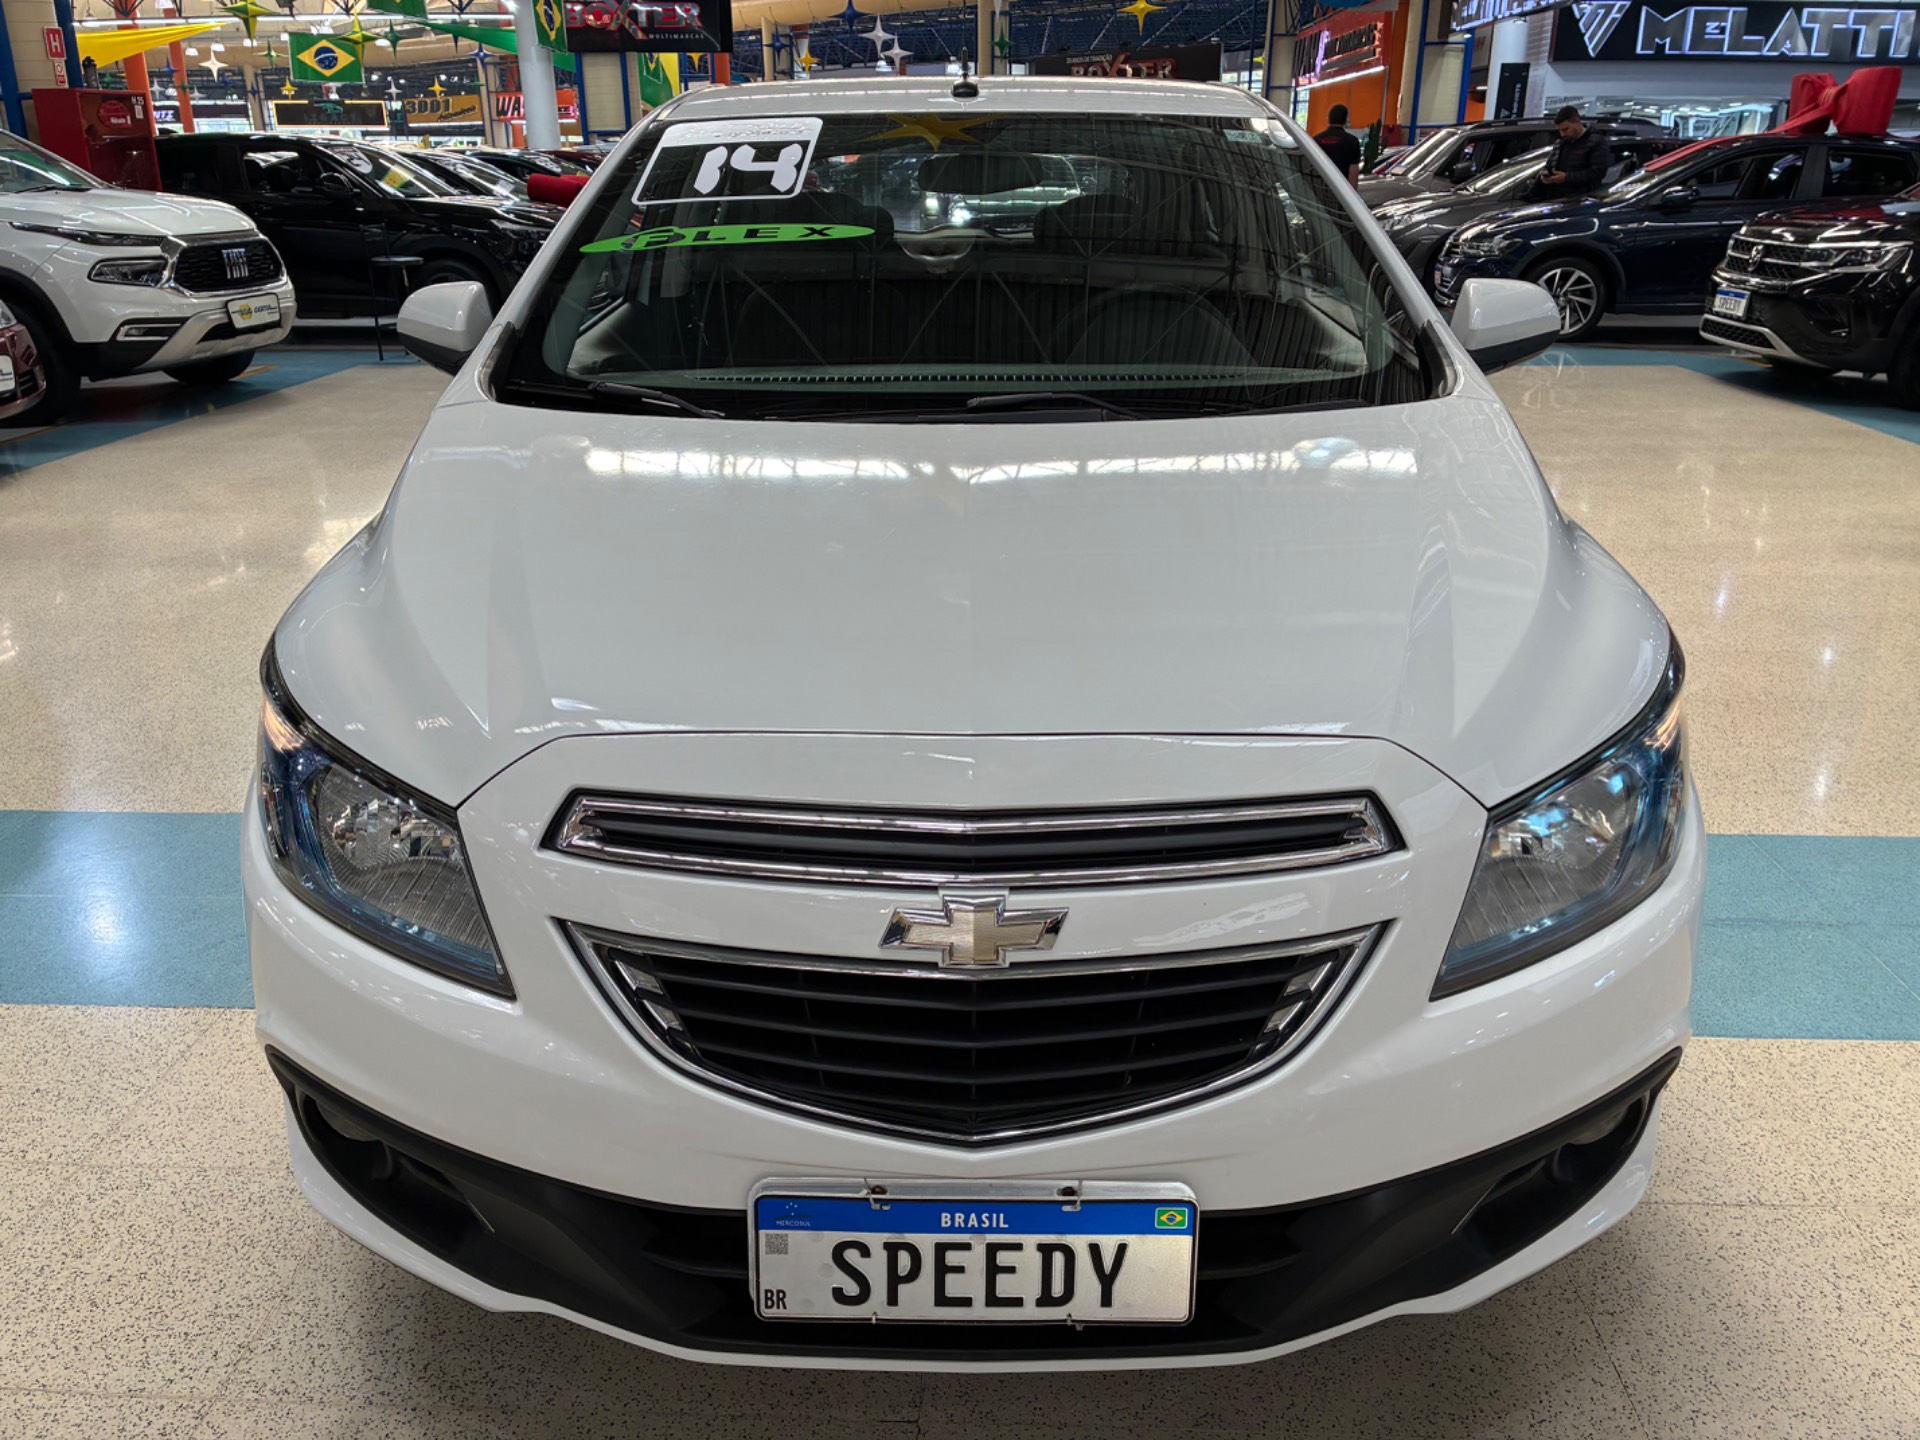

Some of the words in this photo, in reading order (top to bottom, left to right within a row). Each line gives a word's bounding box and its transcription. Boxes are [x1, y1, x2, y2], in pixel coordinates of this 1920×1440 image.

[565, 0, 703, 40] BOXTER
[1635, 6, 1917, 57] MELATTI
[50, 33, 61, 53] H
[693, 144, 803, 194] 14
[637, 226, 835, 249] FLEX
[941, 1213, 1008, 1227] BRASIL
[832, 1240, 1128, 1307] SPEEDY
[764, 1289, 787, 1310] BR
